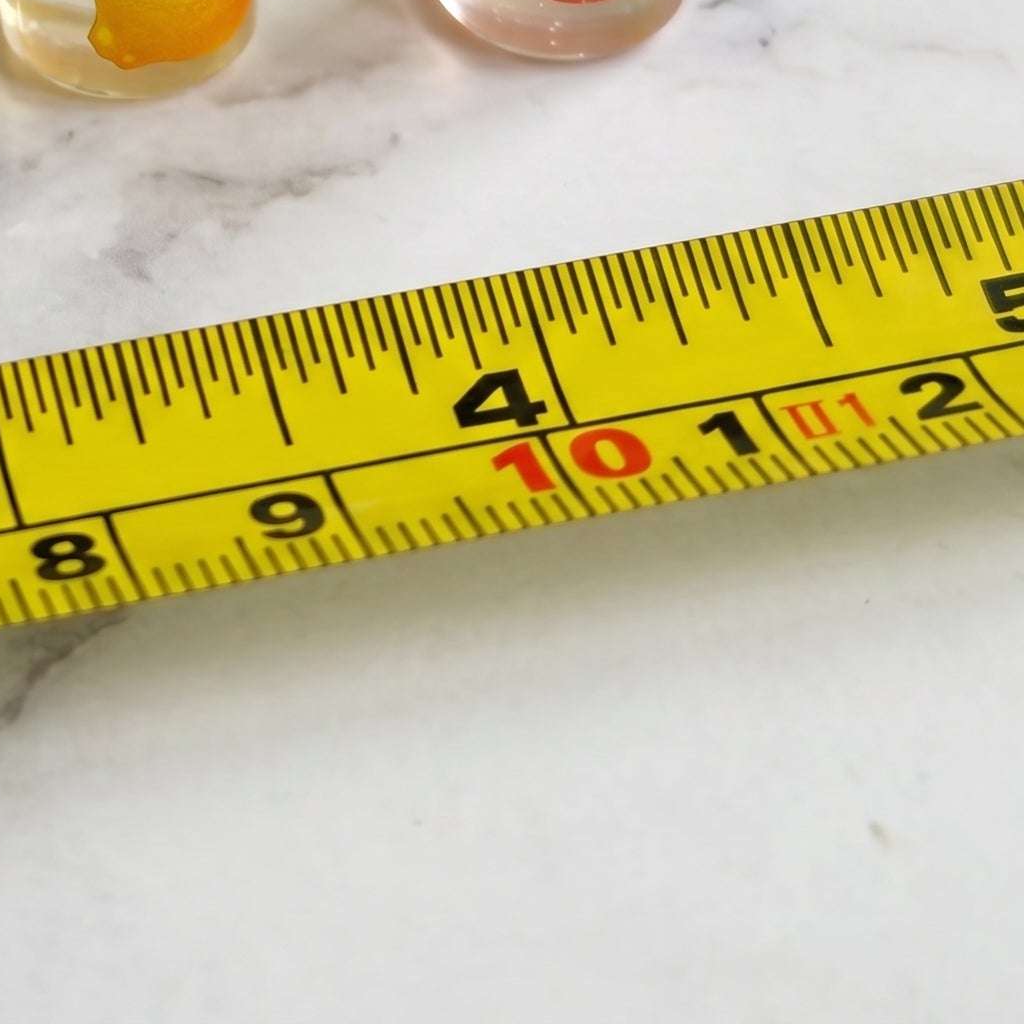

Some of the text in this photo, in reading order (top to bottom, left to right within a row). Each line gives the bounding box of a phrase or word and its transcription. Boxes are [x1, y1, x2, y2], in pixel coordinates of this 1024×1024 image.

[980, 272, 1024, 333] 5
[452, 368, 548, 429] 4
[898, 372, 985, 421] 2
[698, 410, 760, 456] 1
[491, 428, 651, 493] 10
[249, 491, 326, 539] 9
[31, 532, 107, 581] 8
